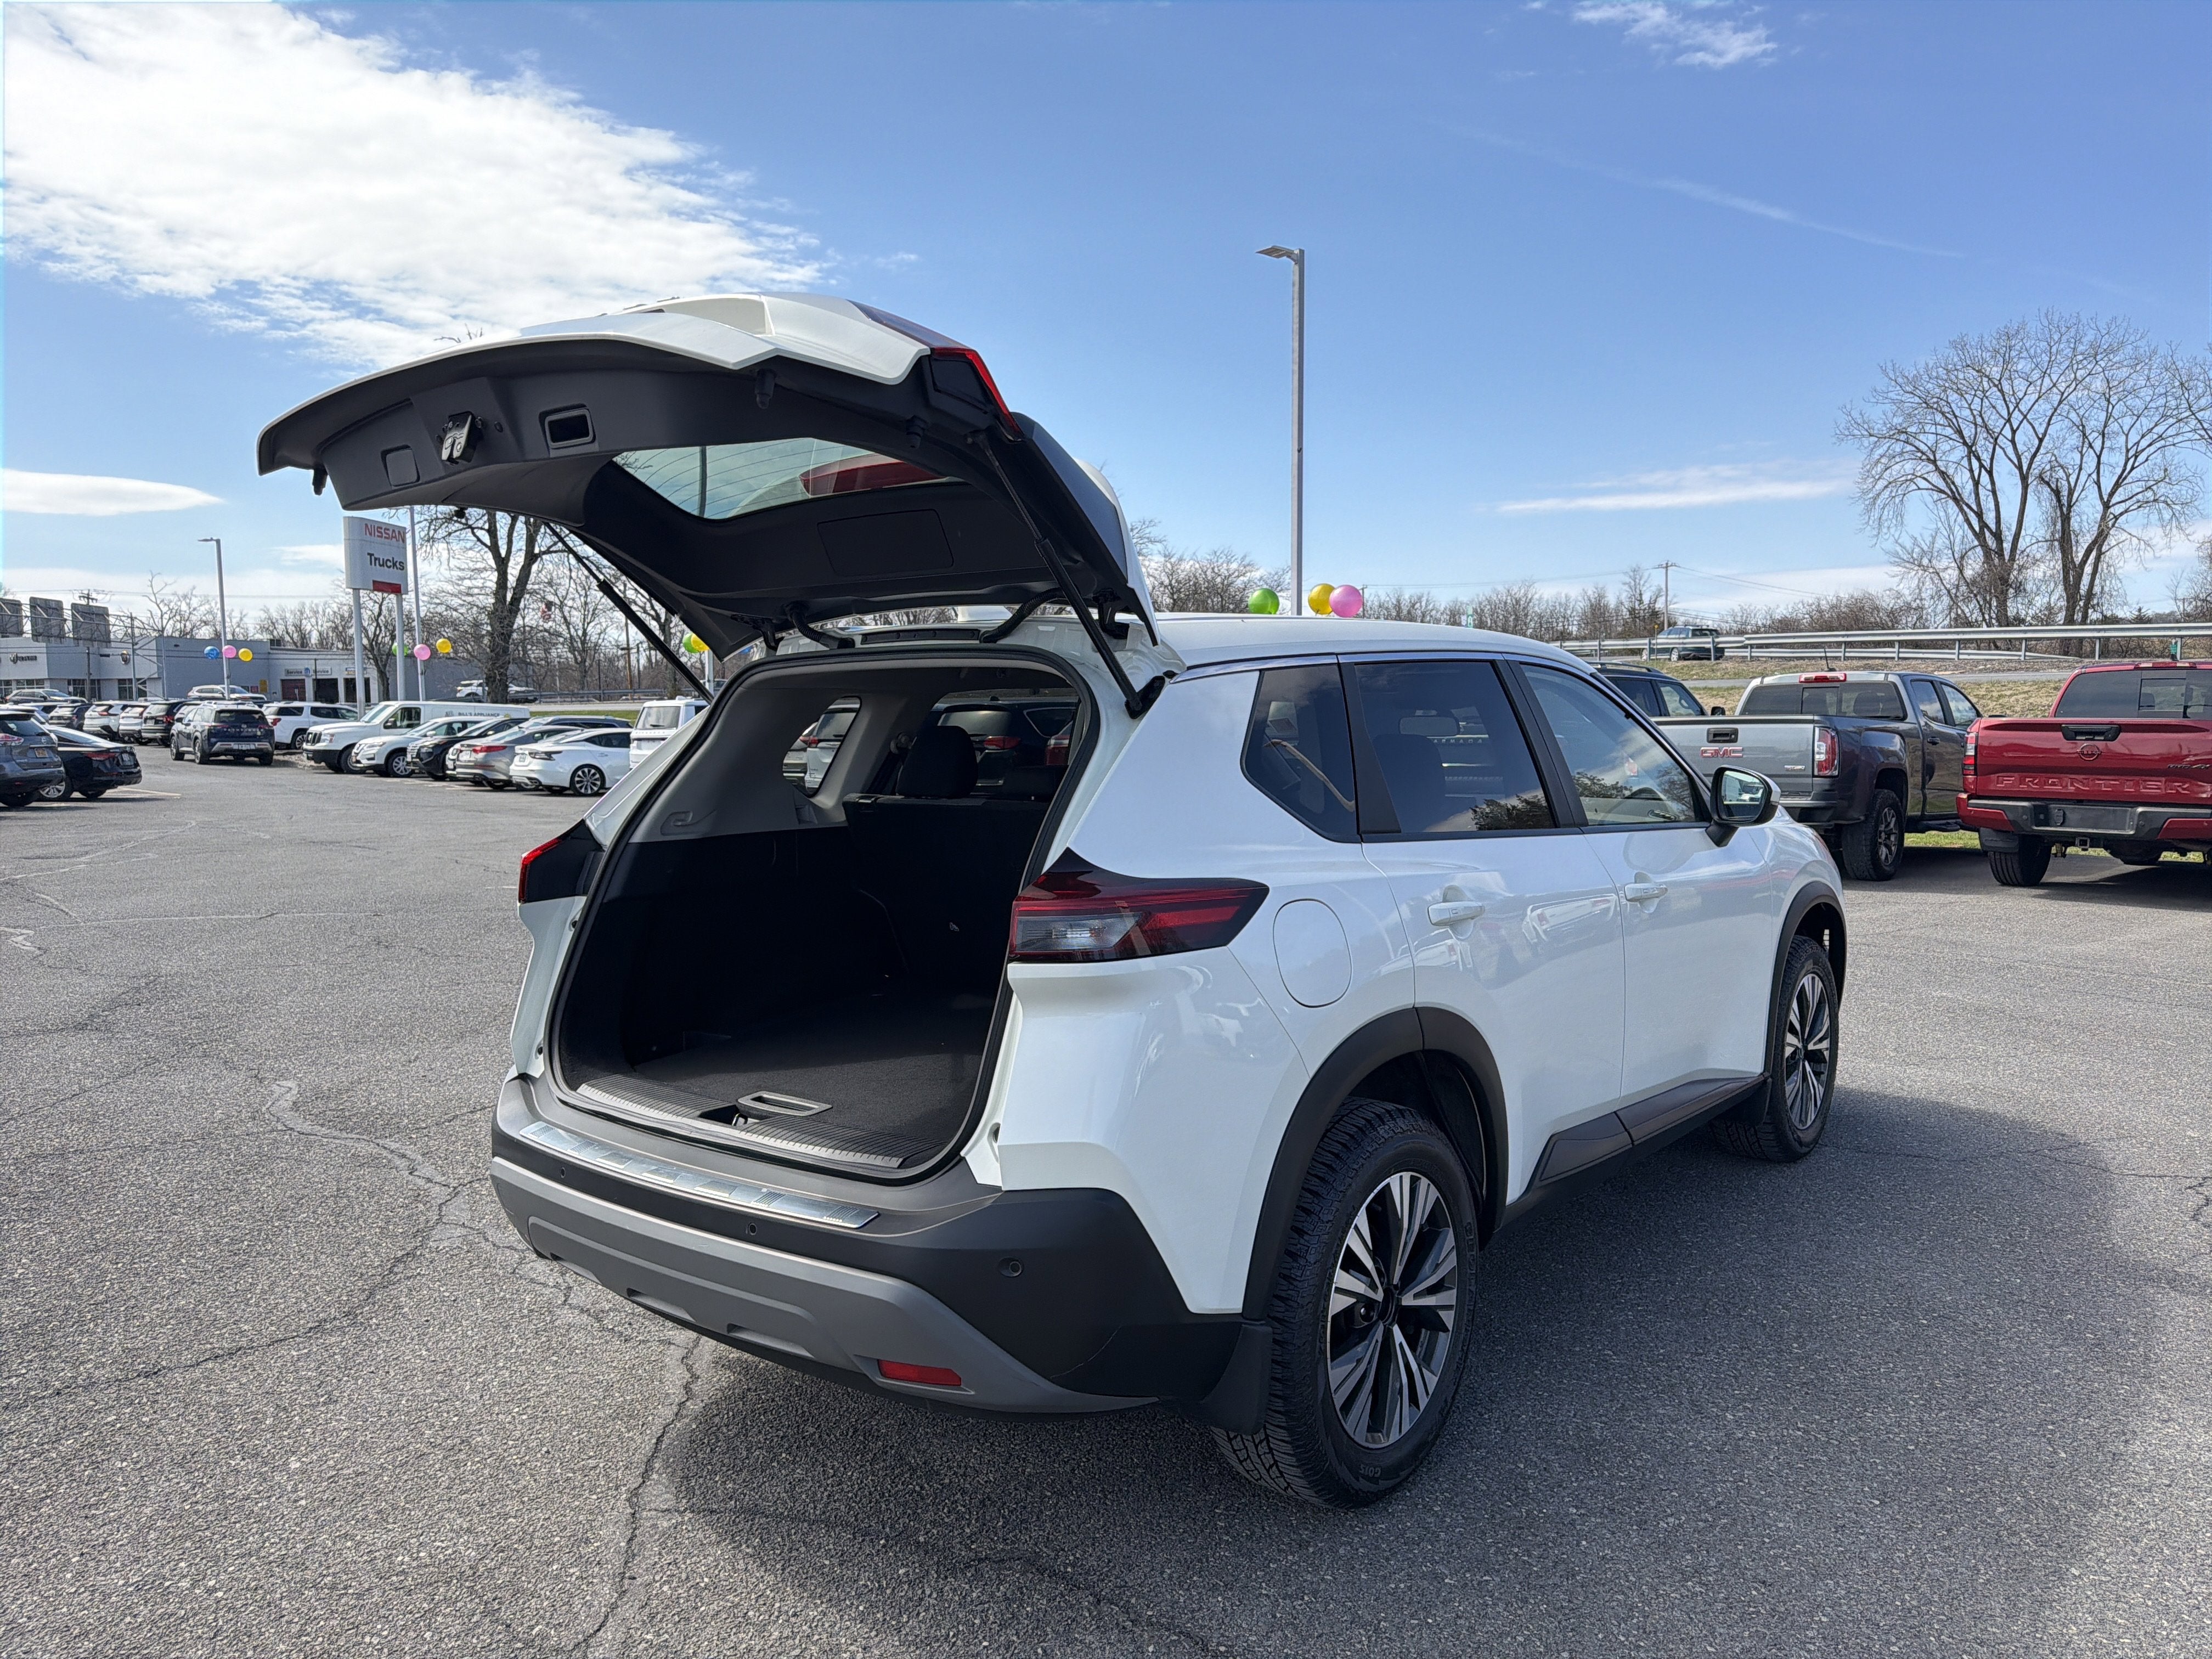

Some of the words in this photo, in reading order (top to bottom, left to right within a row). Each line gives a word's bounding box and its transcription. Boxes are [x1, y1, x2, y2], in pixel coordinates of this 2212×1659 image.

[365, 523, 405, 544] NISSAN
[367, 552, 405, 571] Trucks
[1701, 747, 1743, 758] GMC
[1996, 776, 2191, 794] FRONTIER
